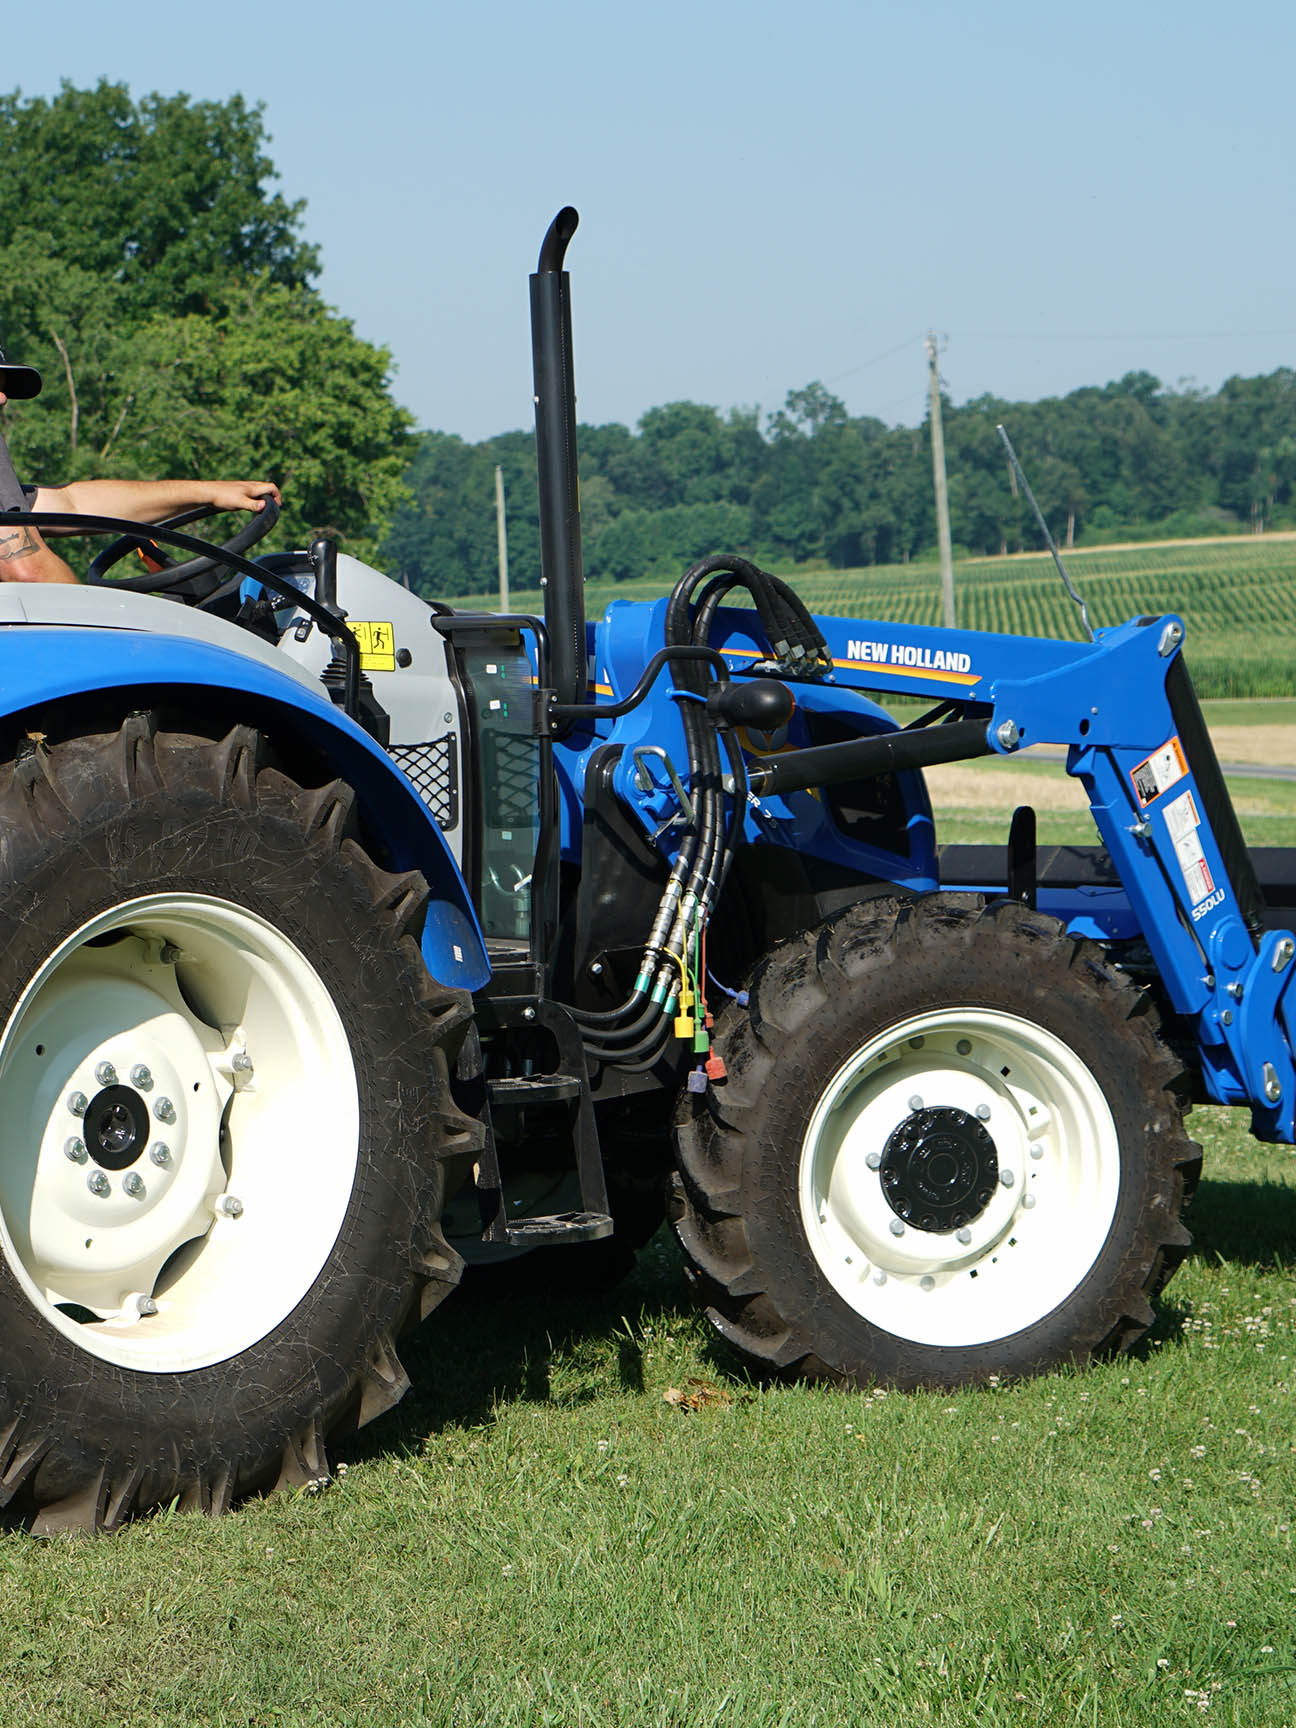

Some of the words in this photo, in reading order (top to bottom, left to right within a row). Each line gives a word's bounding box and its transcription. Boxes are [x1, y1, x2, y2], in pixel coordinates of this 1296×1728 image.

[847, 639, 889, 663] NEW
[891, 644, 972, 673] HOLLAND
[1191, 888, 1225, 922] 550LU
